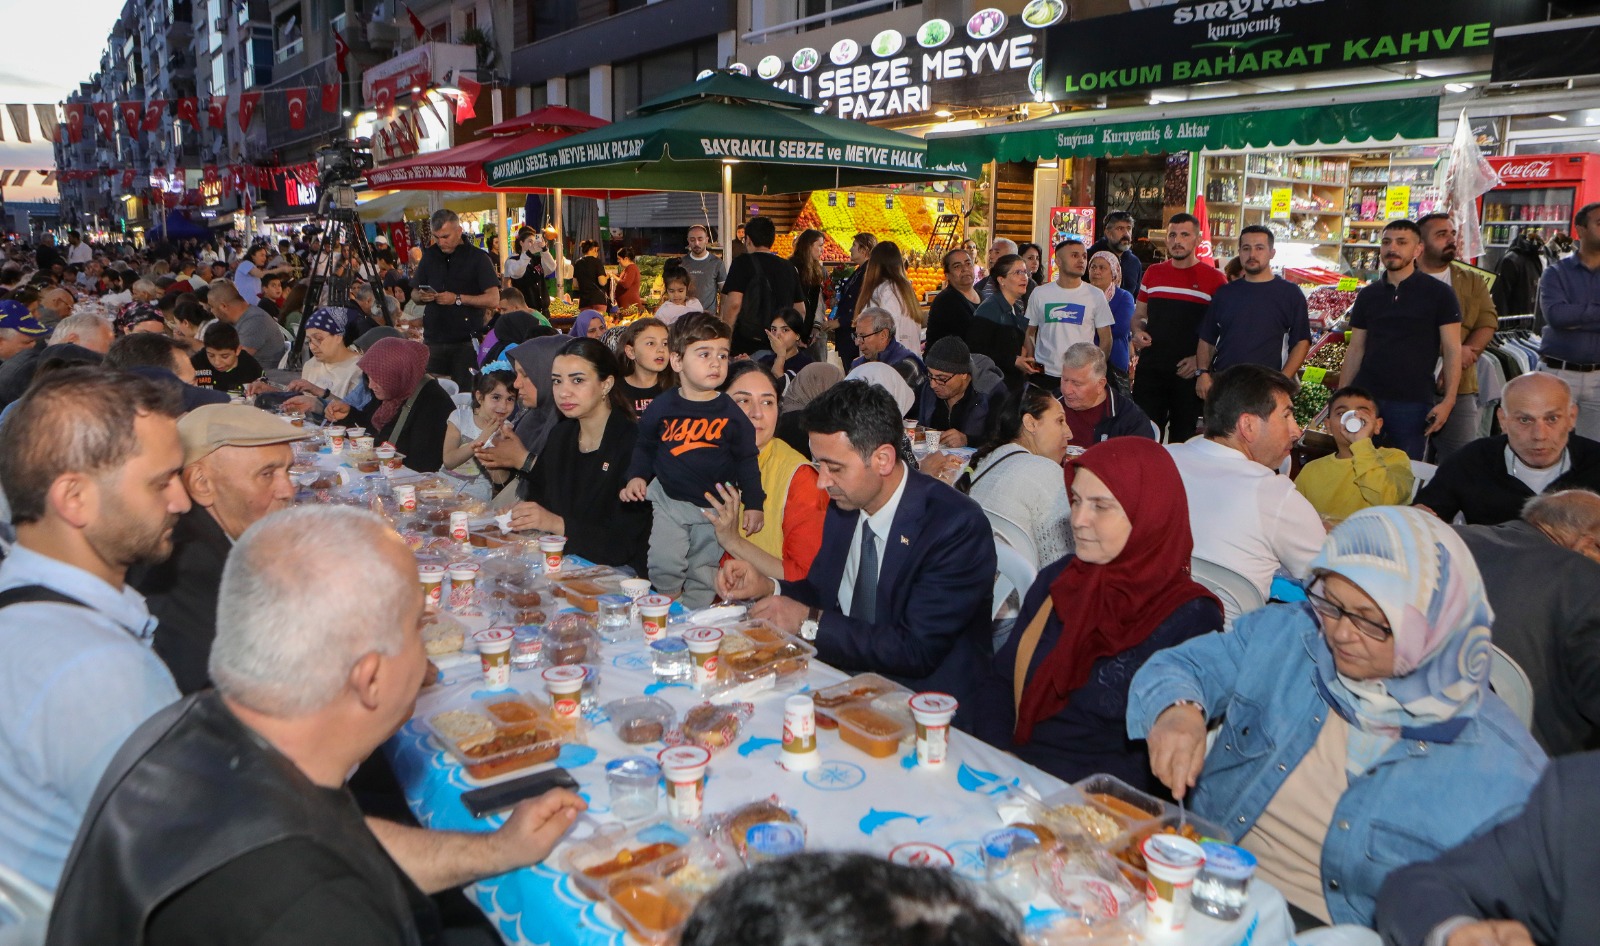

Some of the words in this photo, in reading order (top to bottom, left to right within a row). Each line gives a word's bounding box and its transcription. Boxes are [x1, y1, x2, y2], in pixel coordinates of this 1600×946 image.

[1207, 14, 1281, 41] kuruyemiş
[818, 57, 911, 98] SEBZE
[922, 34, 1036, 81] MEYVE
[1065, 64, 1161, 92] LOKUM
[1172, 42, 1331, 80] BAHARAT
[1343, 22, 1491, 61] KAHVE
[838, 84, 931, 119] PAZARI
[1057, 133, 1094, 149] Smyrna
[1102, 128, 1160, 145] Kuruyemiş
[1163, 125, 1173, 140] &
[1176, 122, 1210, 139] Aktar
[493, 158, 525, 180] BAYRAKLI
[525, 152, 549, 172] SEBZE
[549, 154, 558, 168] ve
[558, 145, 586, 165] MEYVE
[587, 142, 610, 161] HALK
[701, 138, 775, 158] BAYRAKLI
[778, 140, 824, 160] SEBZE
[827, 146, 841, 161] ve
[844, 144, 888, 165] MEYVE
[890, 149, 923, 169] HALK
